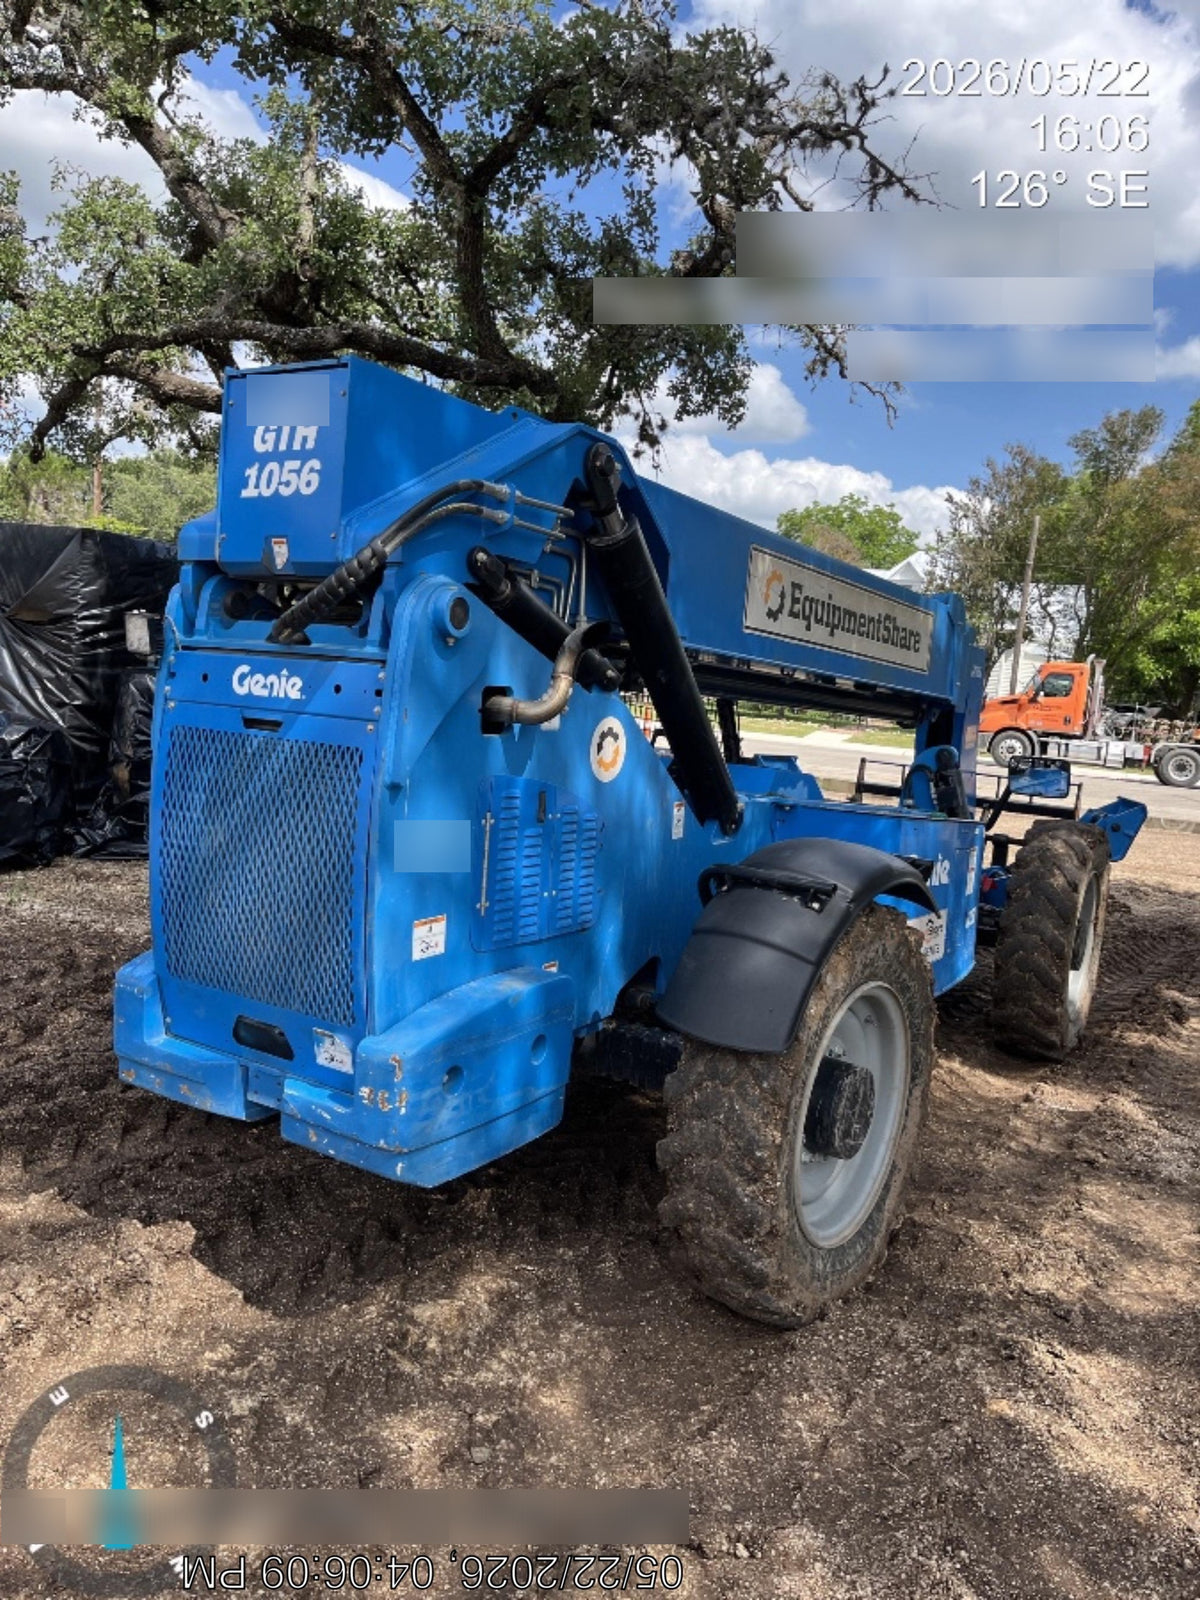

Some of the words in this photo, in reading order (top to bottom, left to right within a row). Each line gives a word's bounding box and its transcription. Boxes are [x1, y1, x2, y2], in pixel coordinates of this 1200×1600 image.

[240, 458, 322, 498] 1056
[787, 580, 922, 652] EquipmentShare
[232, 664, 304, 700] Genie
